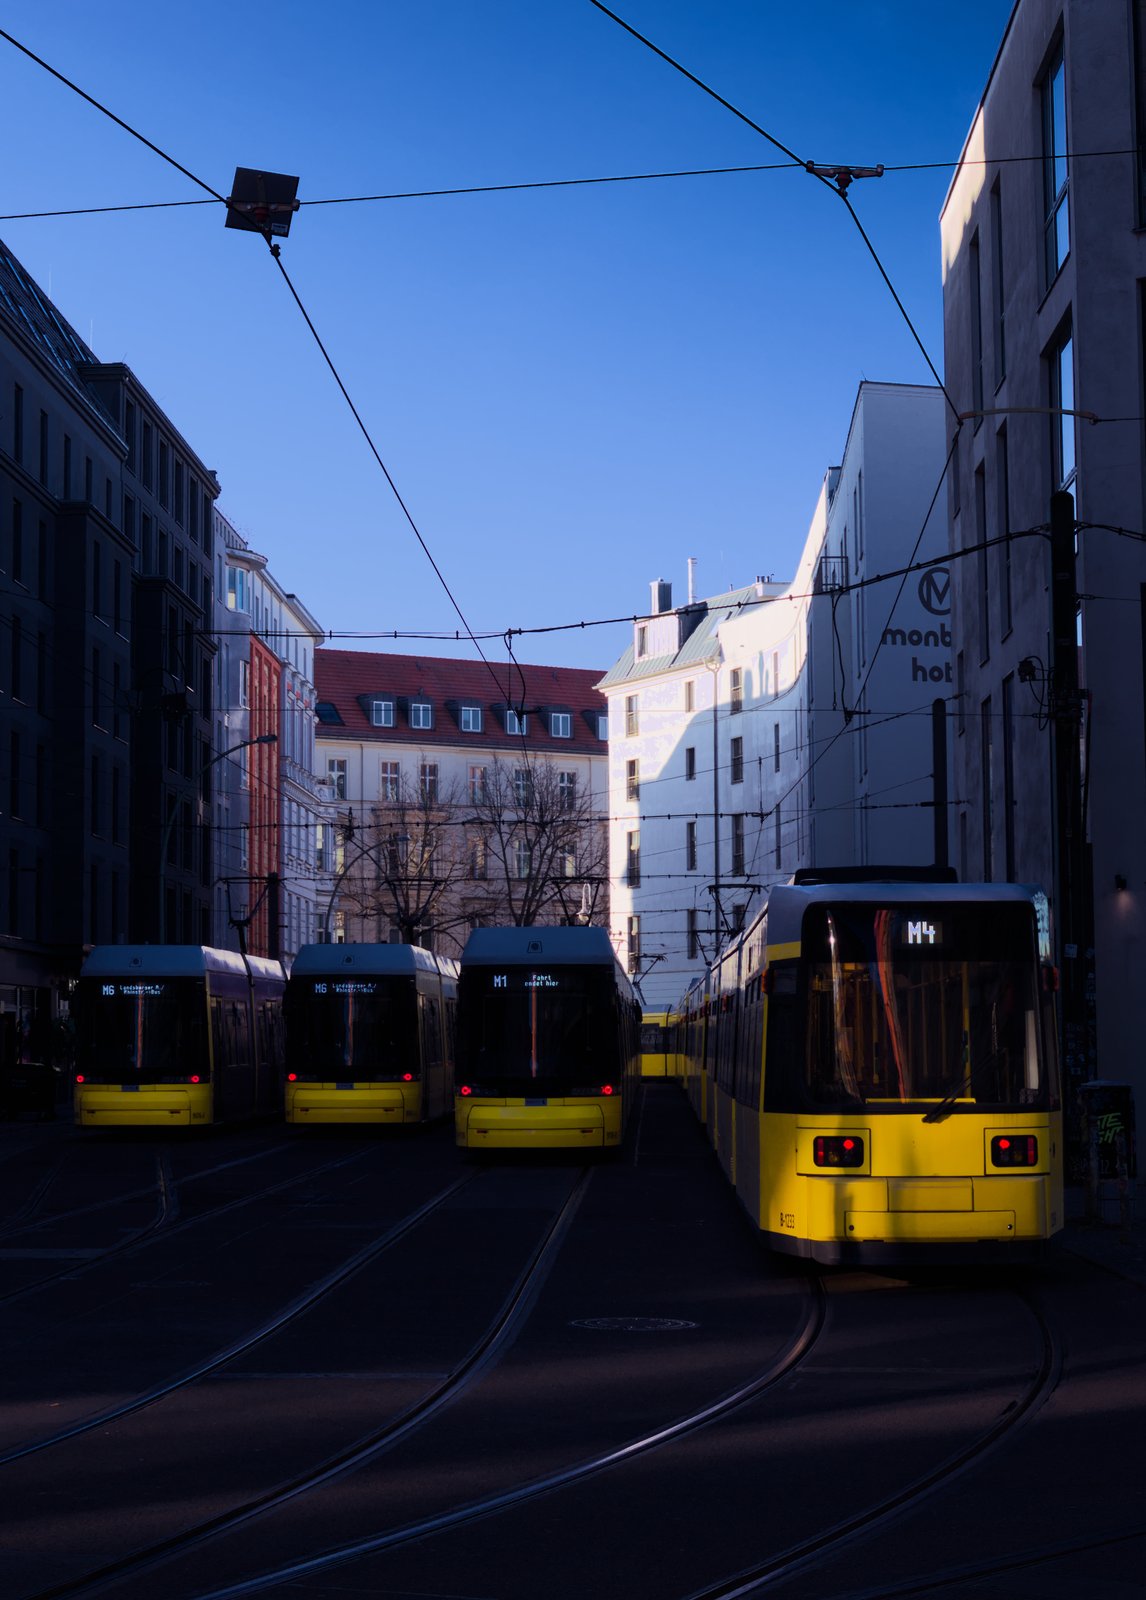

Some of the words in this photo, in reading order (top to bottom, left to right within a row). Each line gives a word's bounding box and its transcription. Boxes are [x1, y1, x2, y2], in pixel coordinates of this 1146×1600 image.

[908, 921, 936, 945] M4
[493, 974, 507, 988] M1
[102, 984, 115, 996] M6
[315, 983, 328, 994] M6
